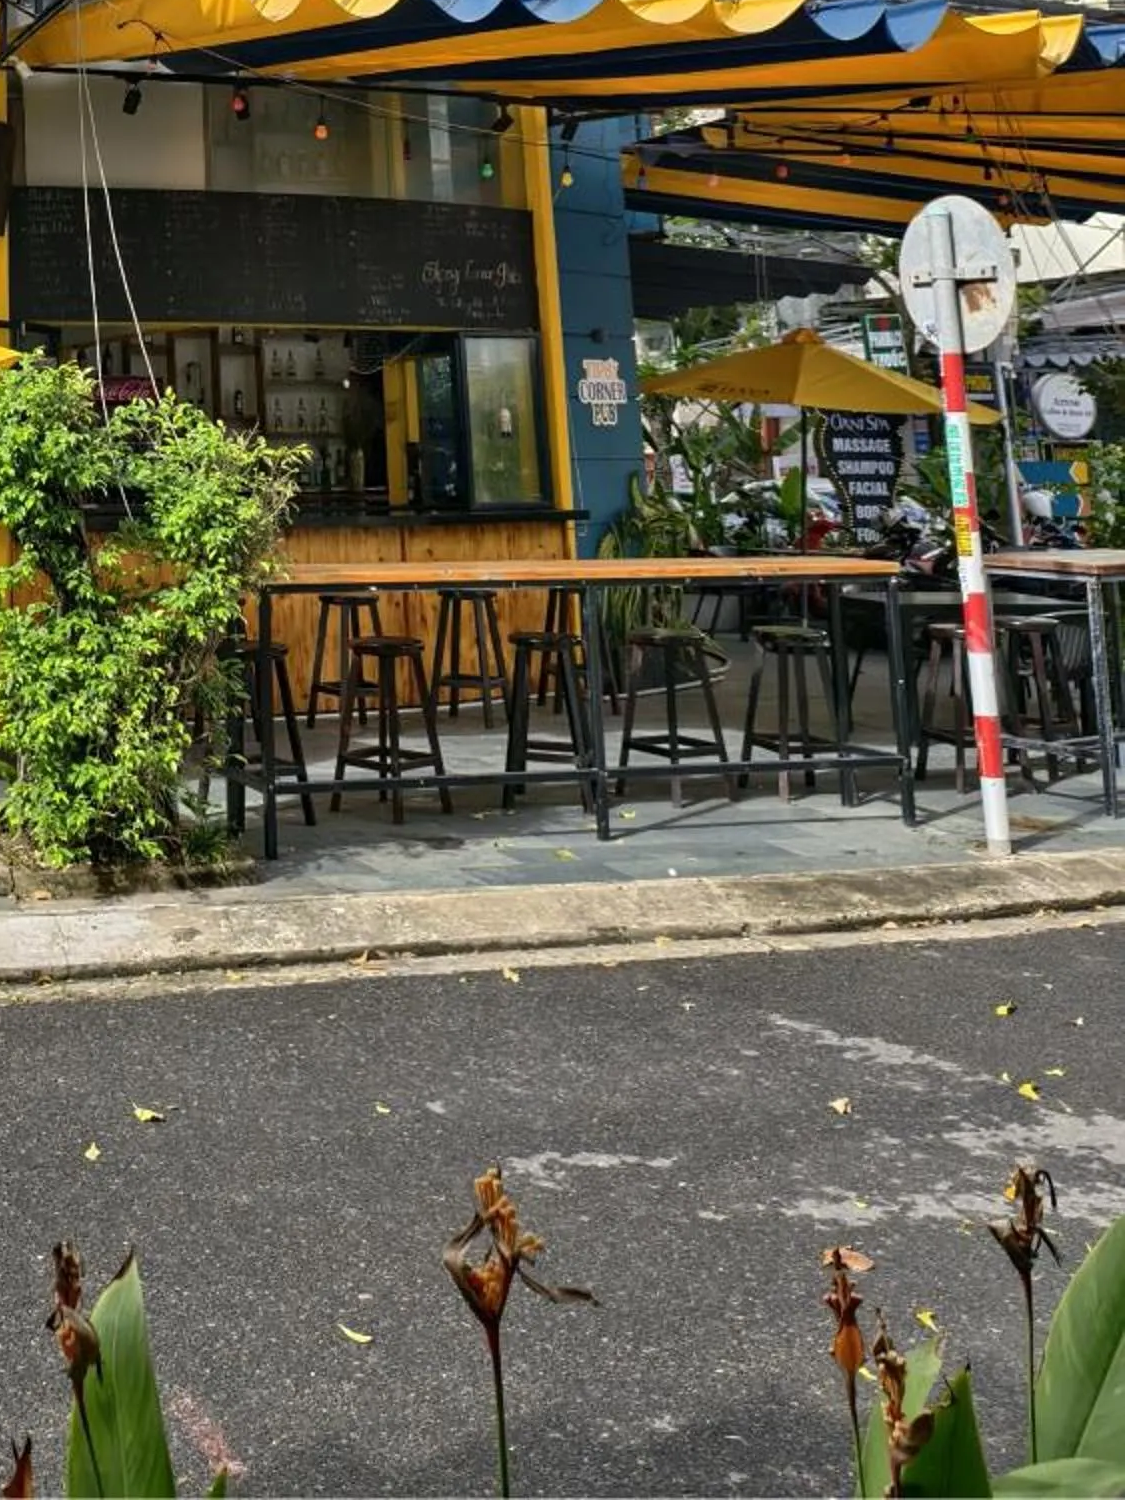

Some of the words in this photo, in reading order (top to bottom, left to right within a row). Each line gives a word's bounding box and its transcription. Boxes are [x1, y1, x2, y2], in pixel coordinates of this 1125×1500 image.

[579, 380, 626, 401] CORNER
[593, 402, 617, 424] PUB
[866, 414, 891, 431] SPA
[832, 437, 892, 453] MASSAGE
[837, 460, 895, 475] SHAMPOO
[848, 481, 890, 496] FACIAL
